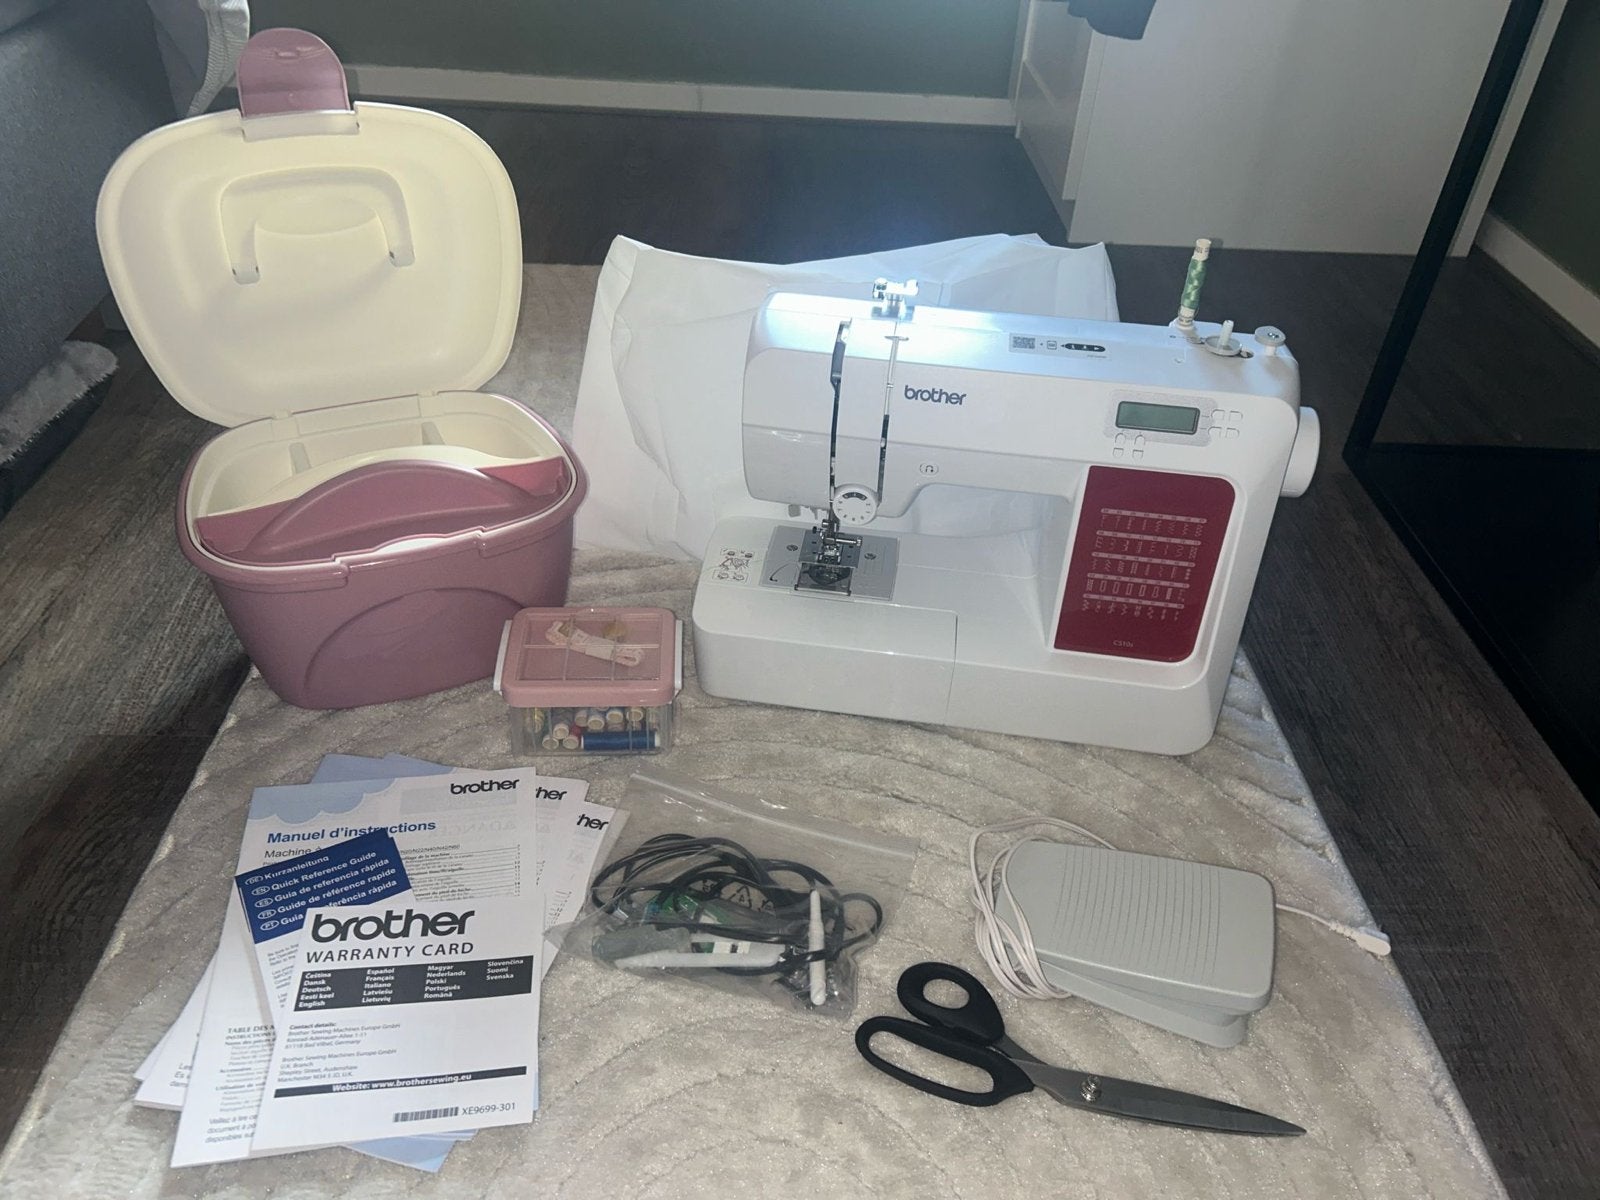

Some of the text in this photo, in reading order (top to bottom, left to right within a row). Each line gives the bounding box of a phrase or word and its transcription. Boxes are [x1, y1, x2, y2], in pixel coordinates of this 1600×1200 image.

[904, 385, 967, 405] brother
[451, 779, 520, 795] brother
[267, 829, 325, 844] Manuel
[264, 847, 312, 859] Machine
[271, 878, 299, 891] Quick
[301, 862, 348, 882] Reference
[349, 852, 376, 866] Guide
[299, 886, 312, 895] de
[313, 870, 360, 890] referencia
[277, 901, 306, 914] Guide
[308, 896, 320, 904] de
[367, 868, 396, 883] rapide
[311, 909, 475, 943] brother
[307, 946, 415, 963] WARRANTY
[421, 942, 474, 956] CARD
[427, 970, 466, 978] Nederlands
[428, 965, 453, 973] Magyar
[311, 1028, 331, 1036] Sewing
[305, 1054, 326, 1062] Sewing
[356, 1049, 376, 1057] Europe
[332, 1073, 472, 1093] Website: www.brothersewing.eu
[462, 1102, 516, 1116] XE9699-301
